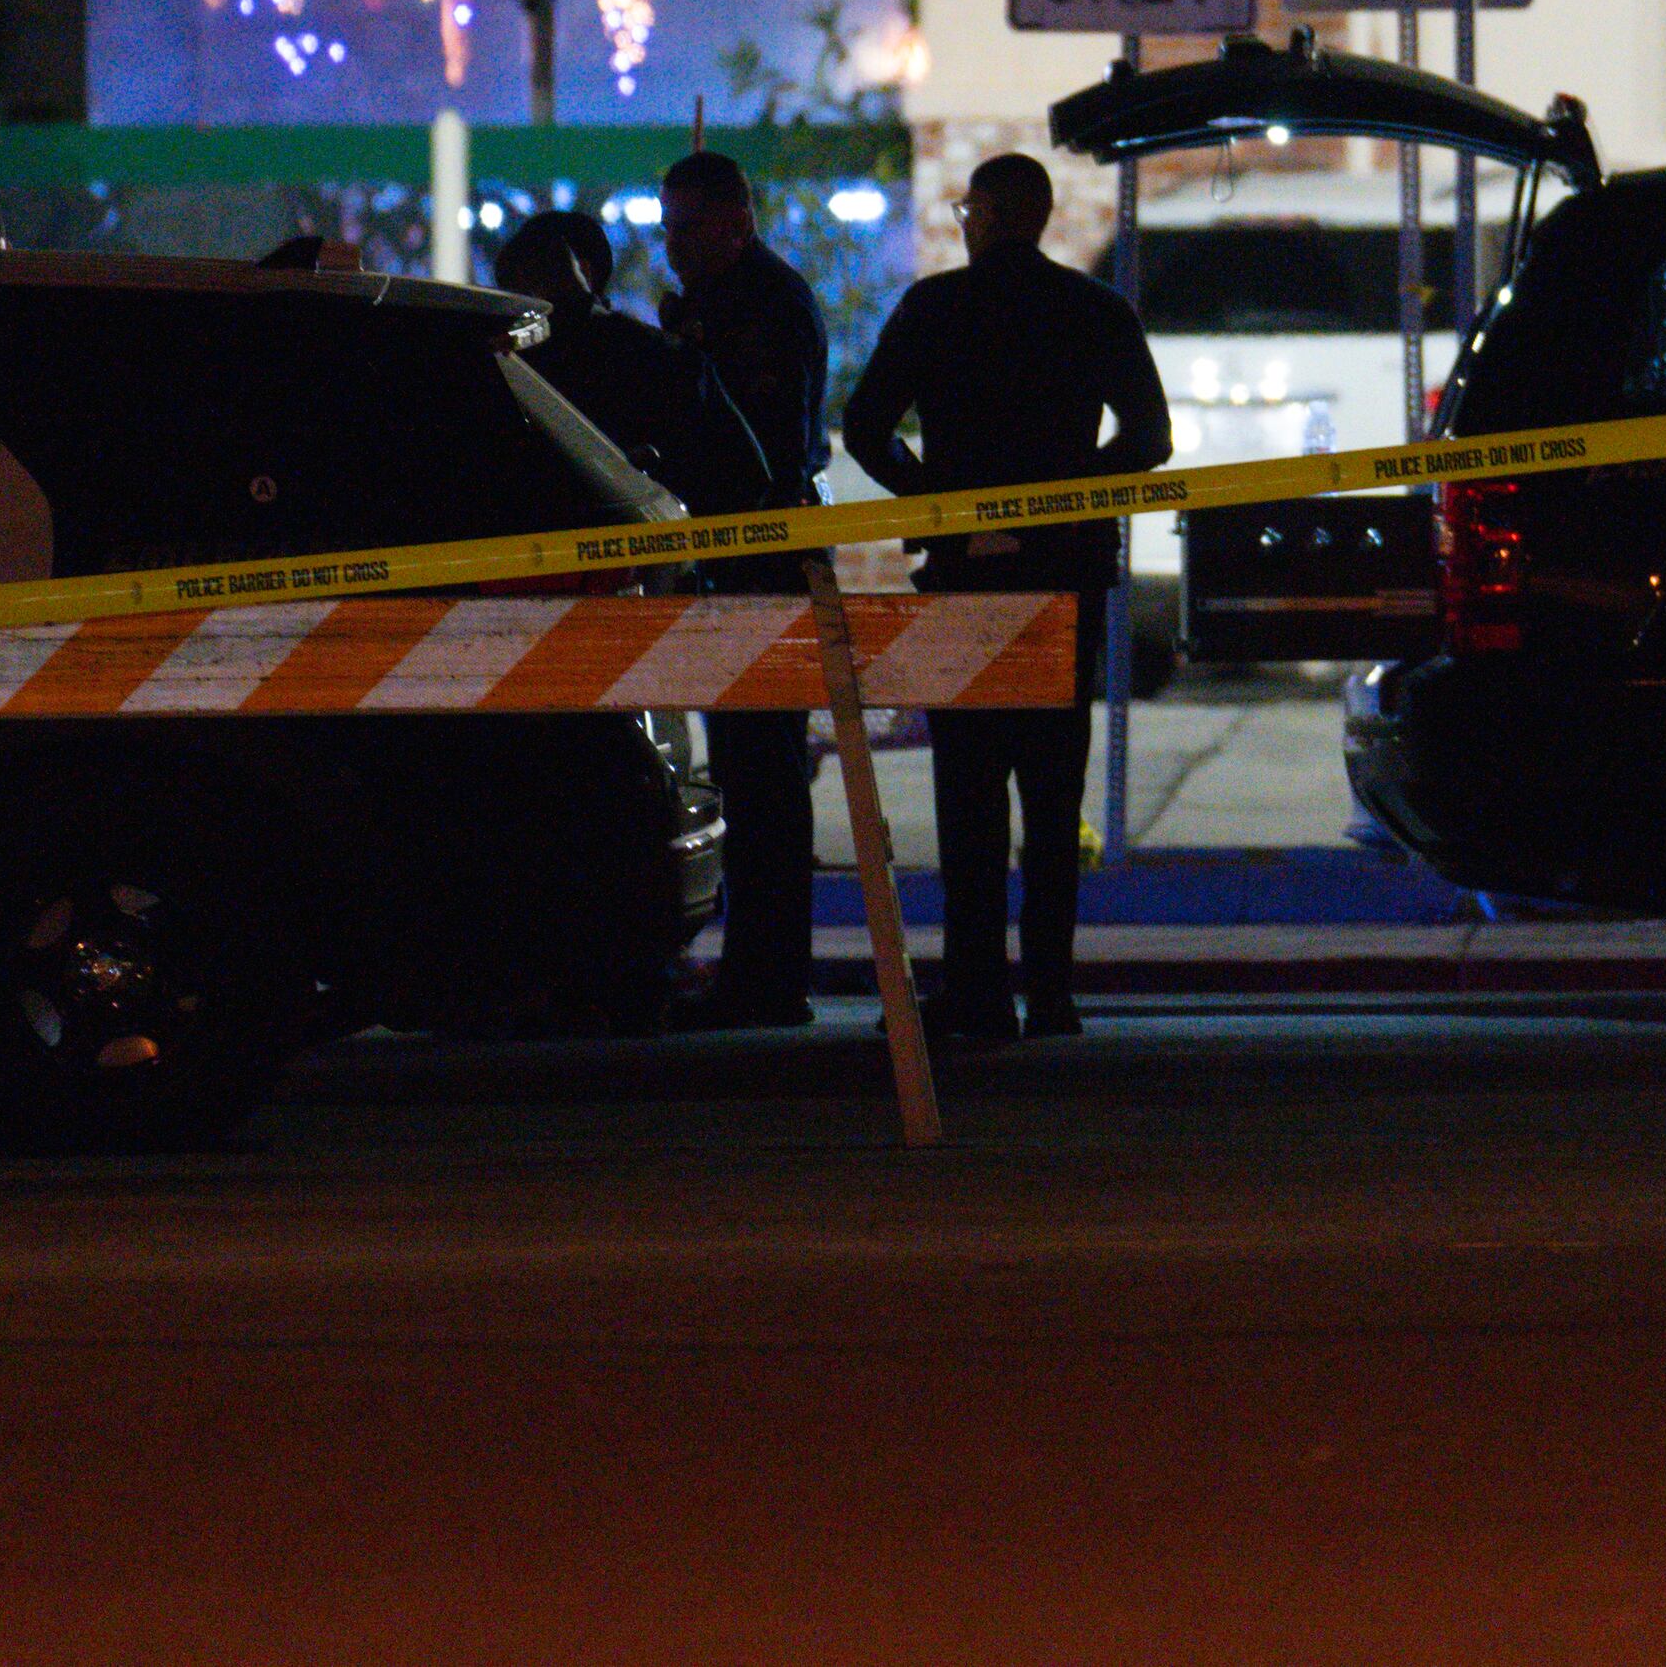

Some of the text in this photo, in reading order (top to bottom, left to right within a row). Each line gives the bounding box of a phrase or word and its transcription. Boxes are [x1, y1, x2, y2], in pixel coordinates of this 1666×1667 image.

[1373, 455, 1421, 479] POLICE
[1510, 442, 1536, 465] NOT
[1540, 437, 1586, 461] CROSS
[975, 498, 1023, 521] POLICE
[1112, 485, 1138, 507] NOT
[1141, 480, 1188, 504] CROSS
[576, 538, 625, 561] POLICE
[713, 526, 740, 548] NOT
[743, 521, 788, 544] CROSS
[176, 576, 224, 599] POLICE
[314, 565, 340, 586] NOT
[343, 560, 389, 583] CROSS
